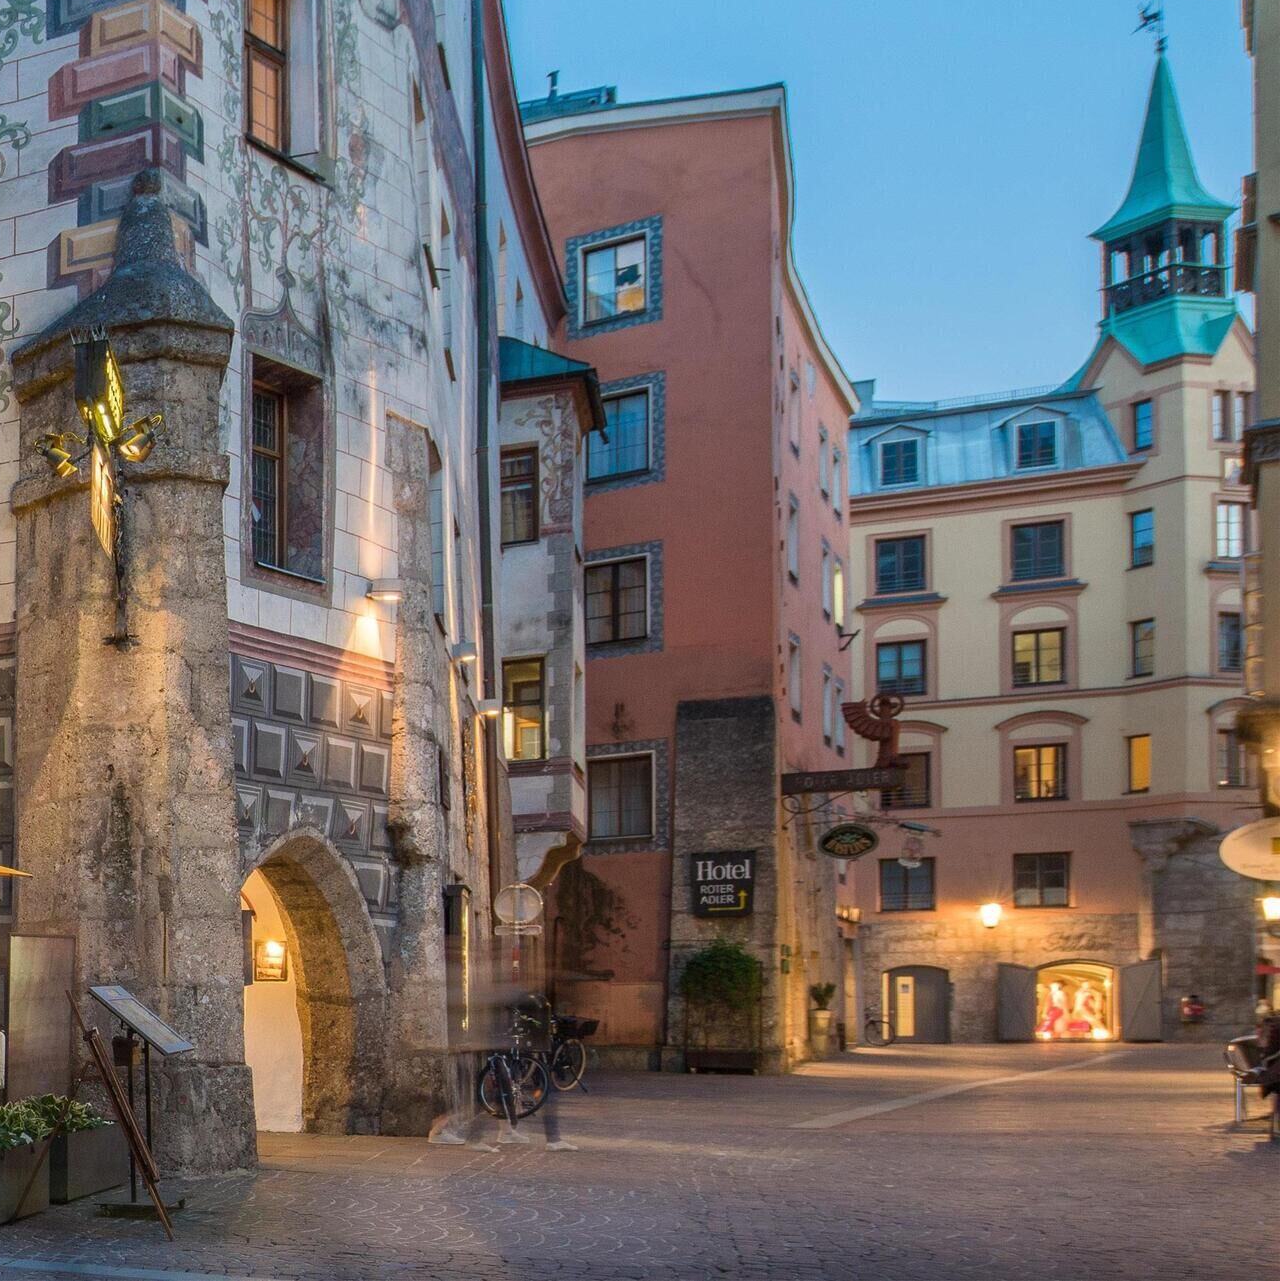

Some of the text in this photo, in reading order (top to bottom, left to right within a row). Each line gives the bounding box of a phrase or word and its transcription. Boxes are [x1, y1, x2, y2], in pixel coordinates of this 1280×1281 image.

[696, 859, 752, 881] Hotel
[700, 884, 735, 894] ROTER
[700, 894, 736, 904] ADLER
